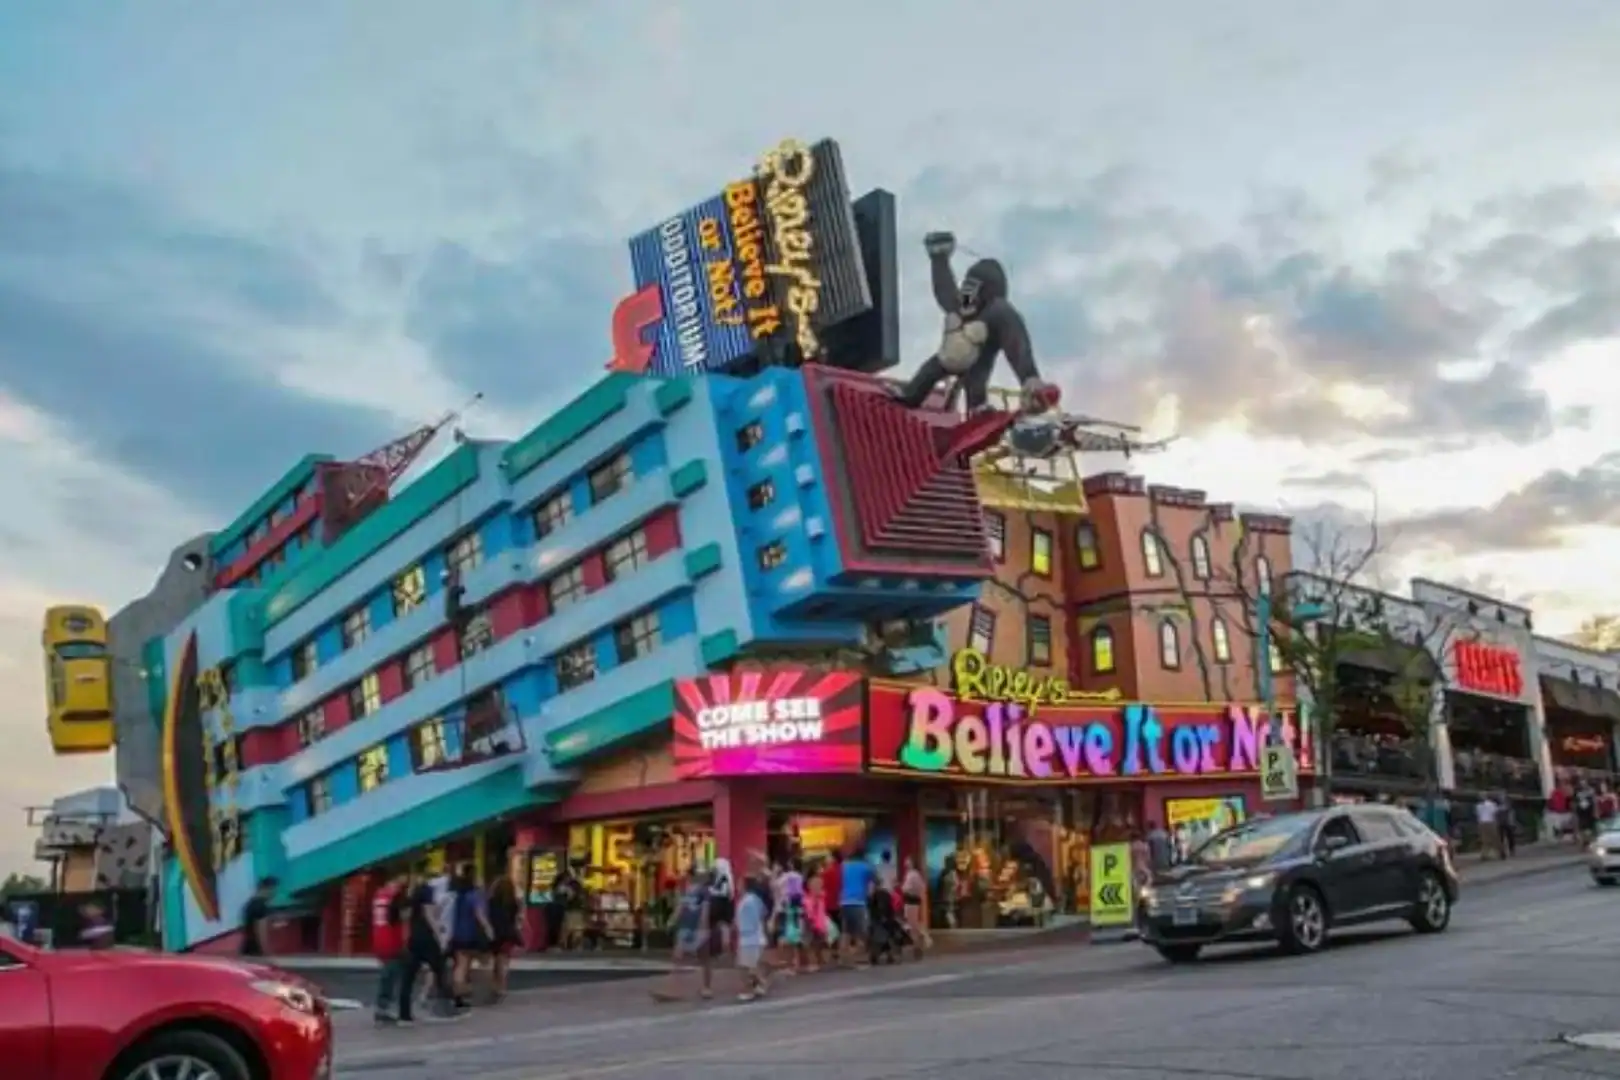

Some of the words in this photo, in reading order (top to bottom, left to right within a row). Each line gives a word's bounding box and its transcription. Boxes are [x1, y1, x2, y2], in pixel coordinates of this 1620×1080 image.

[698, 217, 722, 250] or
[725, 181, 766, 299] Believe
[748, 305, 782, 340] It
[661, 216, 708, 368] ODDITORIUM
[707, 259, 744, 326] Not!
[955, 648, 1121, 717] Ripley's
[696, 700, 769, 729] COME
[774, 697, 820, 720] SEE
[701, 725, 741, 749] THE
[745, 719, 823, 745] SHOW
[902, 686, 1113, 774] Believe
[1121, 703, 1166, 776] It
[1172, 721, 1221, 774] or
[1229, 703, 1311, 772] Nt!
[1267, 752, 1278, 769] P
[1104, 854, 1118, 877] P
